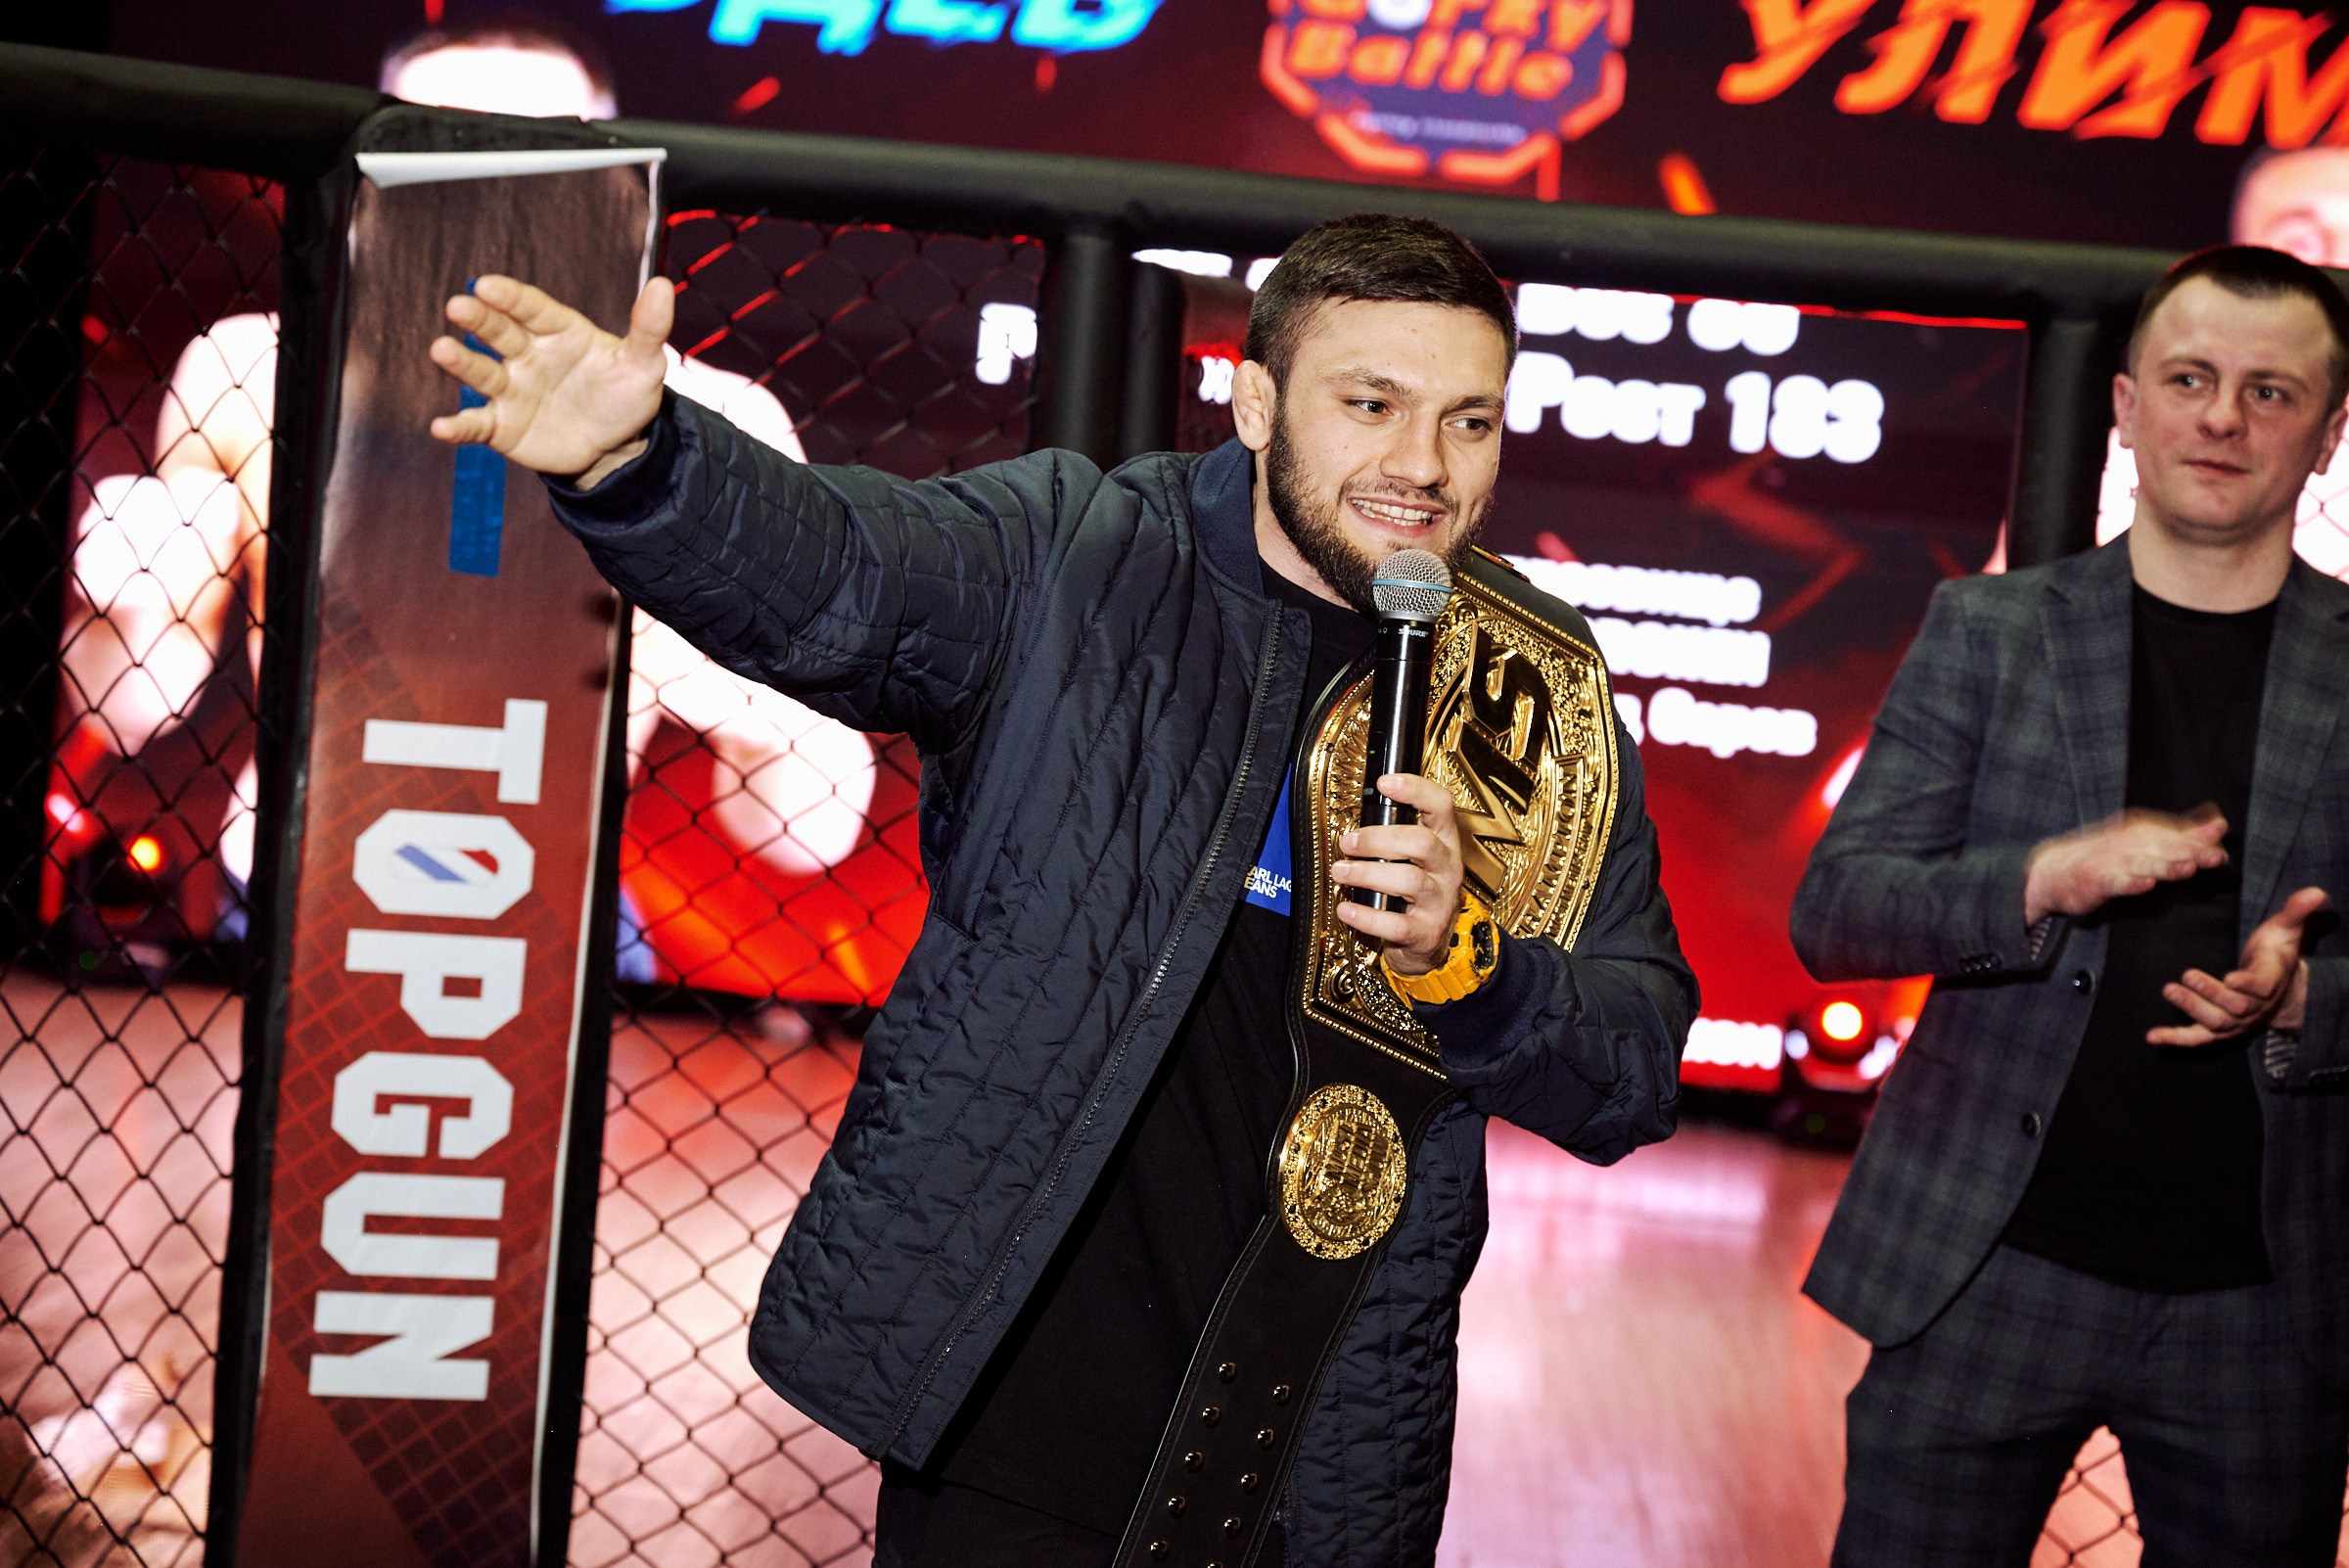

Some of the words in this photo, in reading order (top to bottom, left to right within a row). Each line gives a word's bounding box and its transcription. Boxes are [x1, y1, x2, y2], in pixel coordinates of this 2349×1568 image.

[1283, 17, 1574, 101] Battle
[1244, 876, 1277, 899] EANS
[1247, 865, 1273, 885] ARL
[1273, 873, 1291, 893] LAG
[1514, 759, 1580, 938] HAMPION
[307, 698, 548, 1402] TOPGUN
